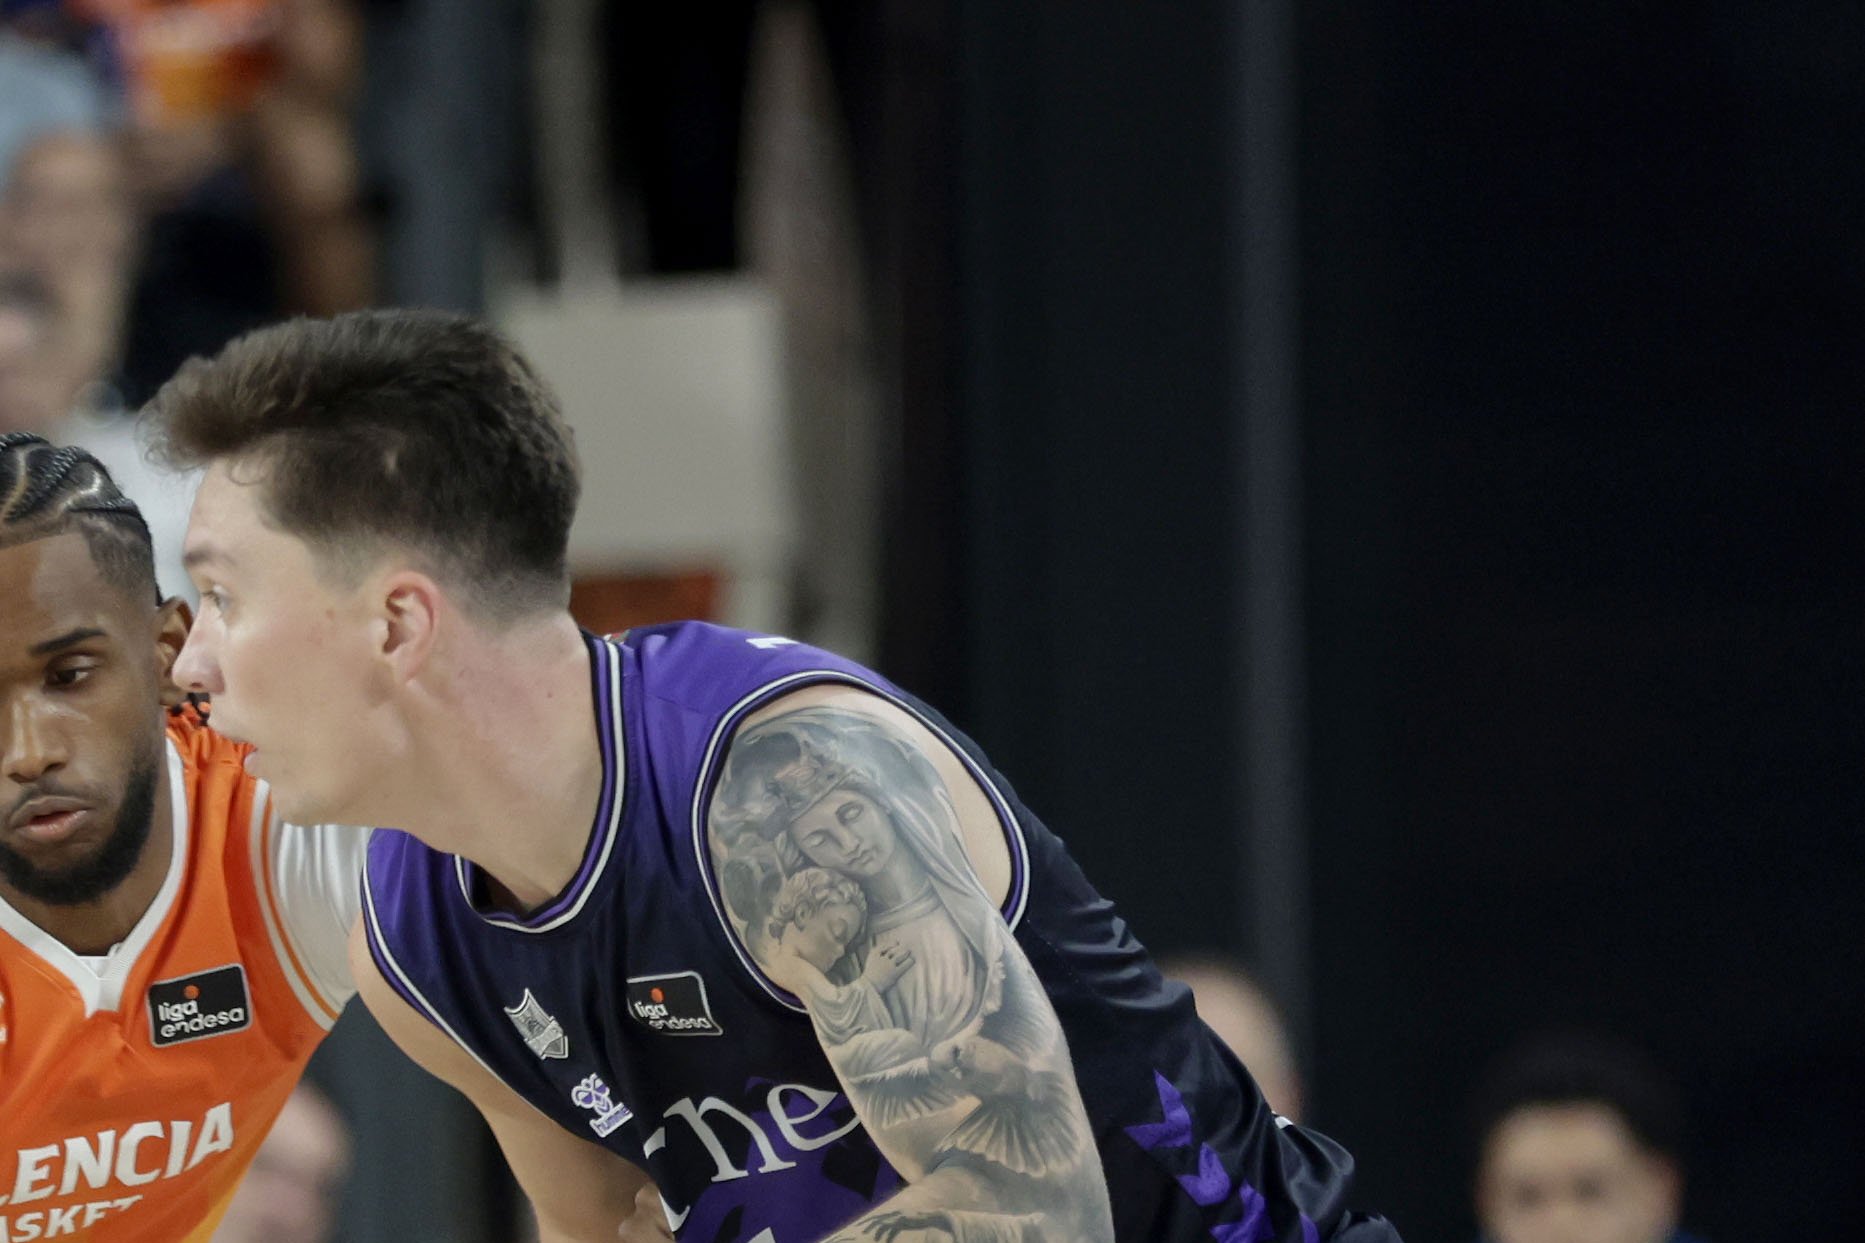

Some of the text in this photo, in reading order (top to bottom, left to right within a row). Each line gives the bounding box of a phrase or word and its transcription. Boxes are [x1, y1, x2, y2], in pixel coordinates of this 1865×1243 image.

[158, 1000, 198, 1021] liga
[635, 1001, 668, 1018] liga
[161, 1008, 244, 1038] endesa
[649, 1016, 712, 1030] endesa
